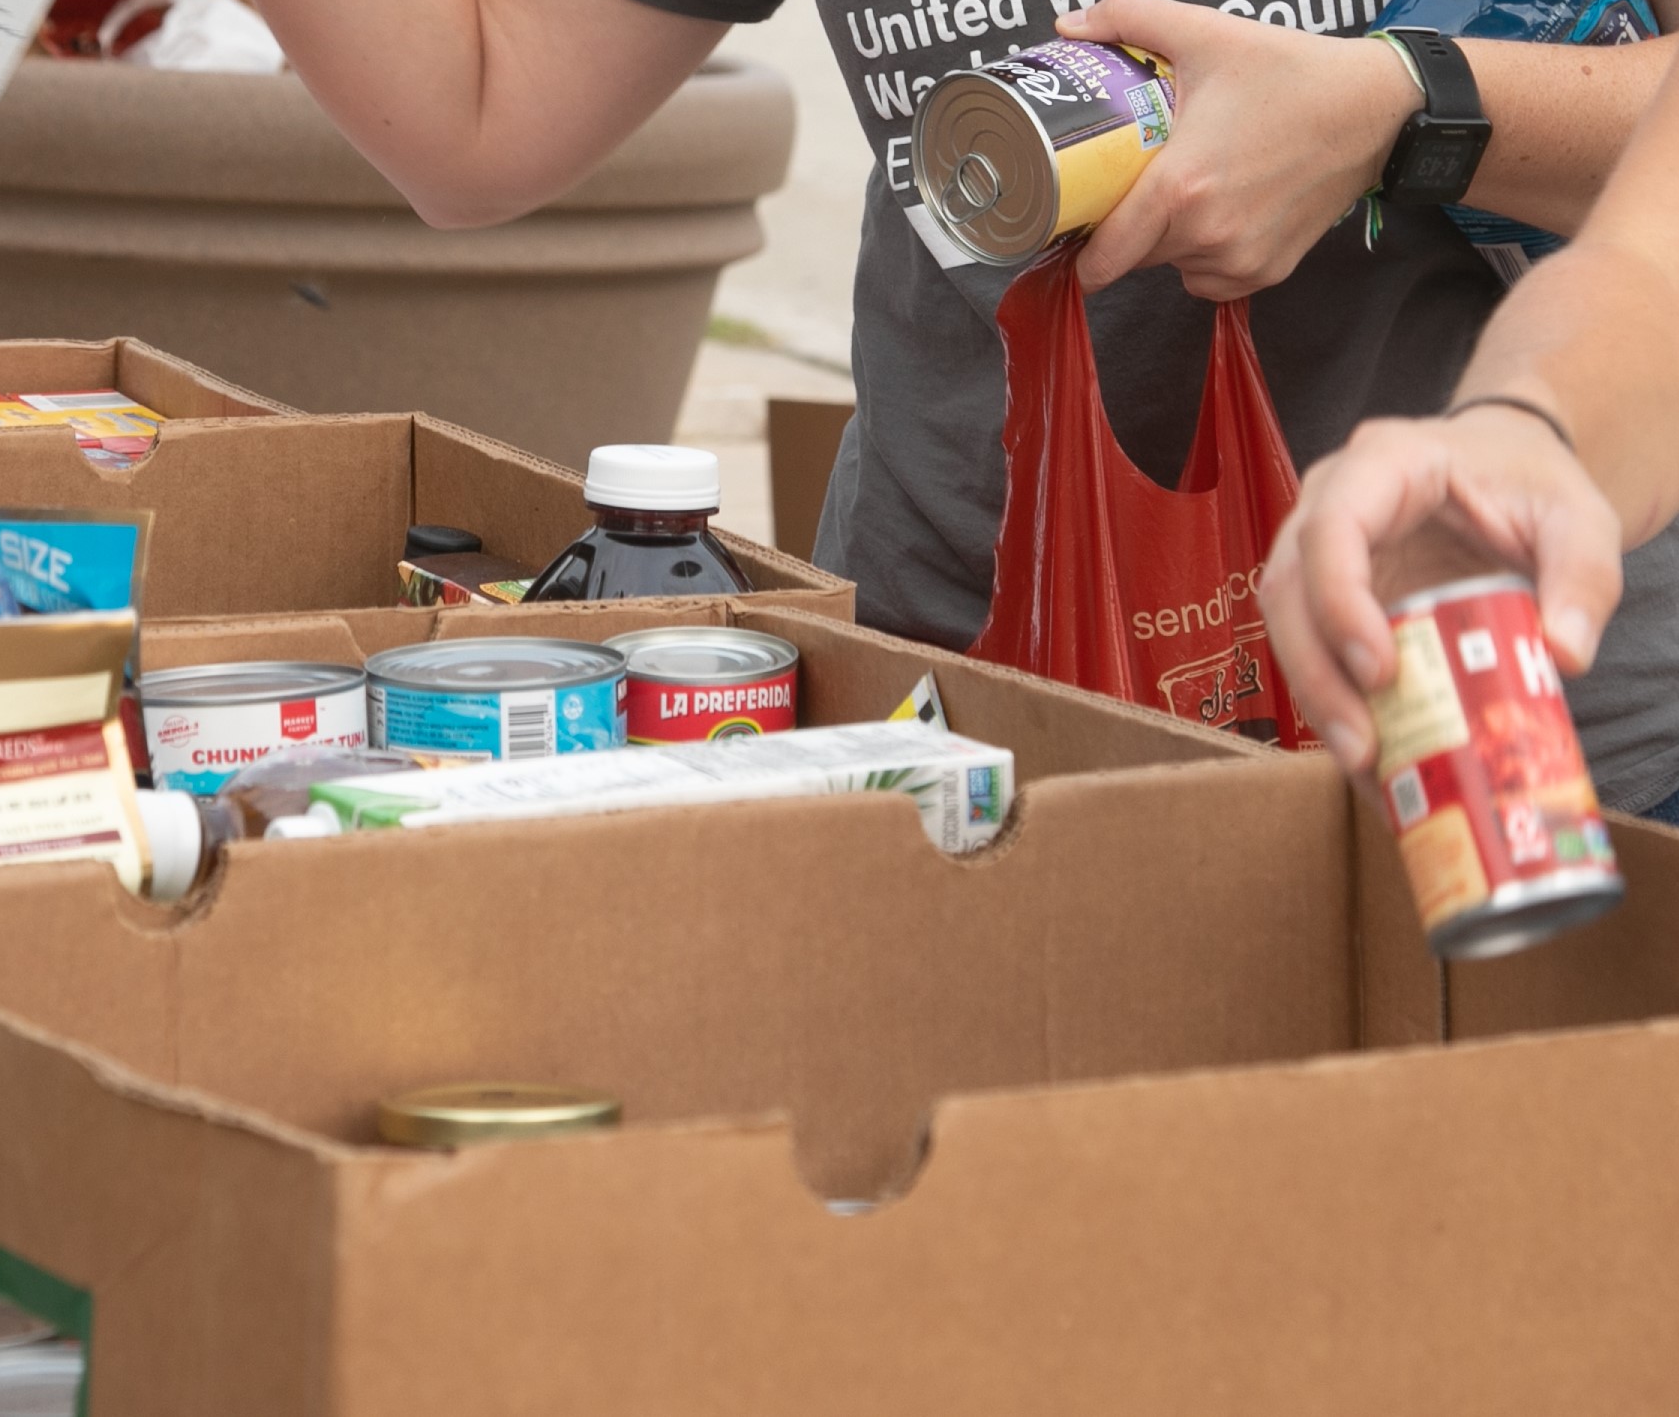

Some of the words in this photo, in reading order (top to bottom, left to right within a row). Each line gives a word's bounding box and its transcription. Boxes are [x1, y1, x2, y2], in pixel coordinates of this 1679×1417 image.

[1035, 41, 1112, 101] ARTICHO
[1037, 54, 1093, 103] DELICATE
[1127, 91, 1145, 117] NON
[1134, 88, 1151, 115] GMO
[1145, 83, 1171, 144] VERIFIED
[0, 529, 74, 594] SIZE
[660, 691, 688, 720] LA
[693, 682, 791, 715] PREFERIDA
[282, 714, 316, 729] MARKET
[192, 747, 270, 765] CHUNK
